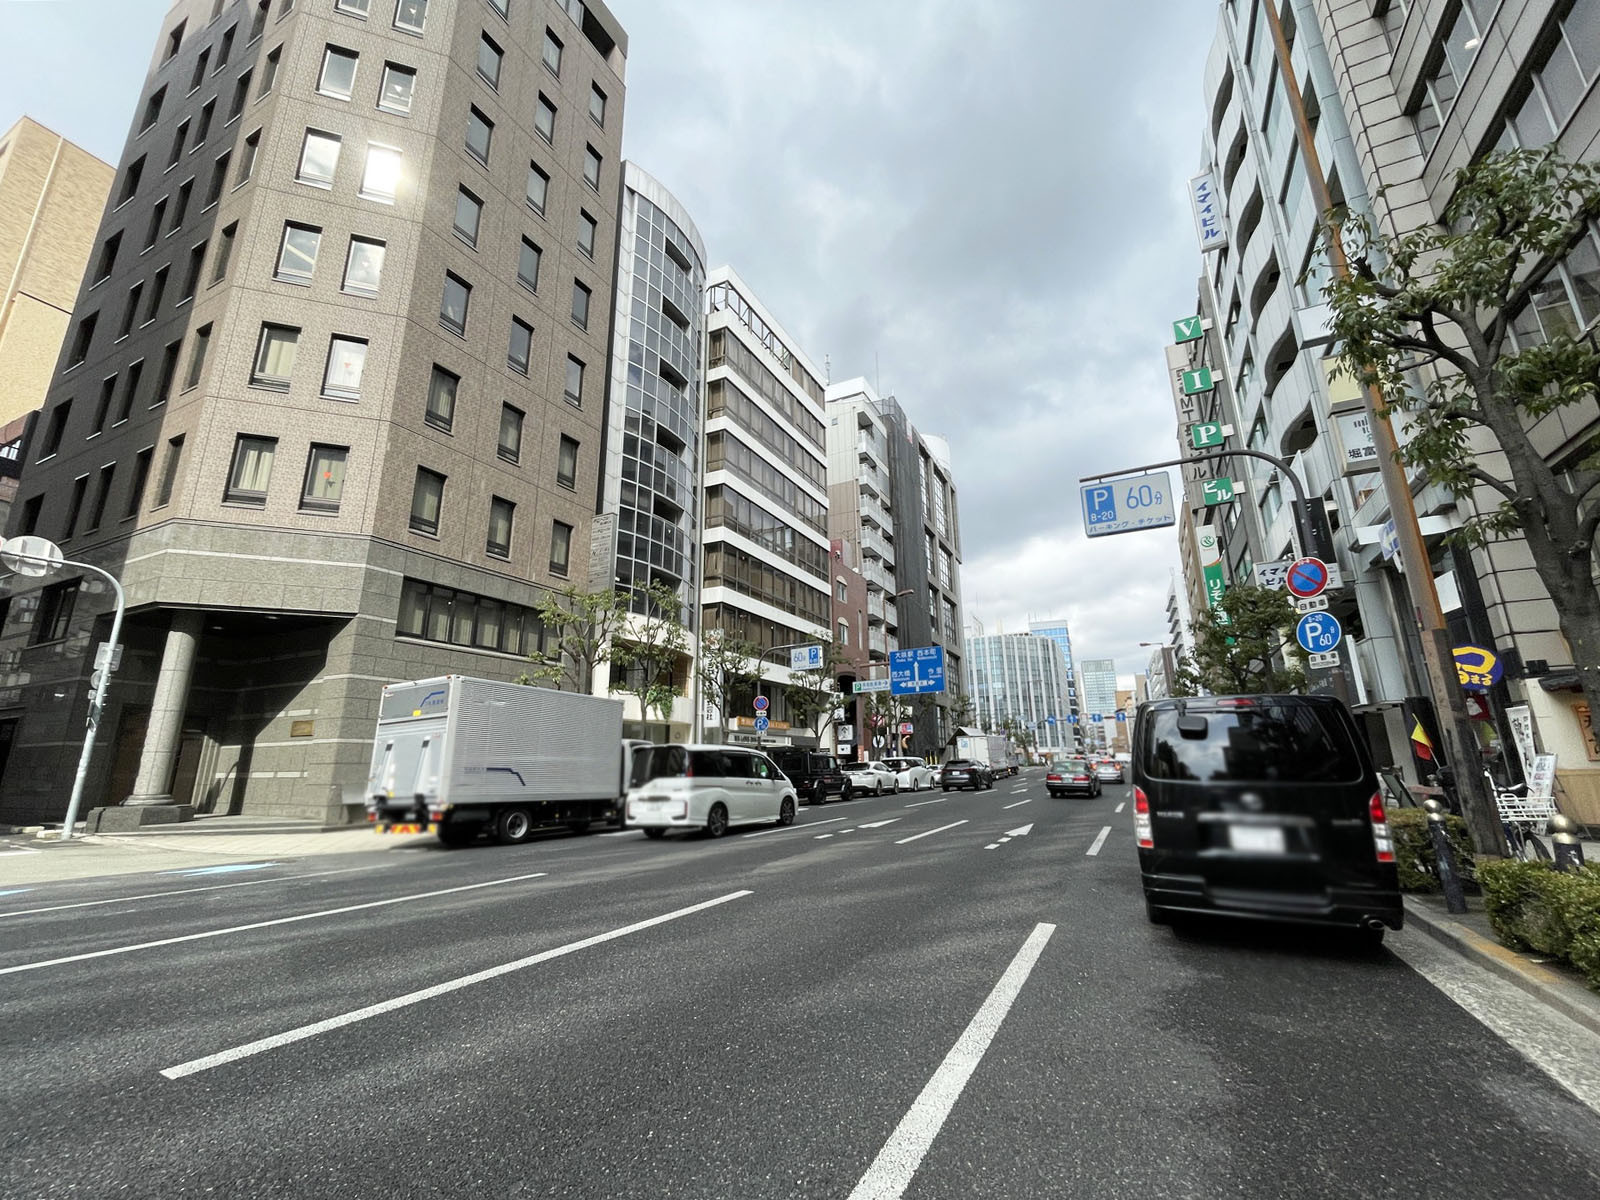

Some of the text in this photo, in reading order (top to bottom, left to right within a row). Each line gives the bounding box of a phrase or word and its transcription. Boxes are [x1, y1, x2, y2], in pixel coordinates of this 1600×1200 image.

[1196, 180, 1220, 240] イマイビル
[1094, 489, 1108, 510] P
[1126, 484, 1163, 510] 60分
[1090, 510, 1114, 522] 8-20
[1304, 622, 1323, 649] P
